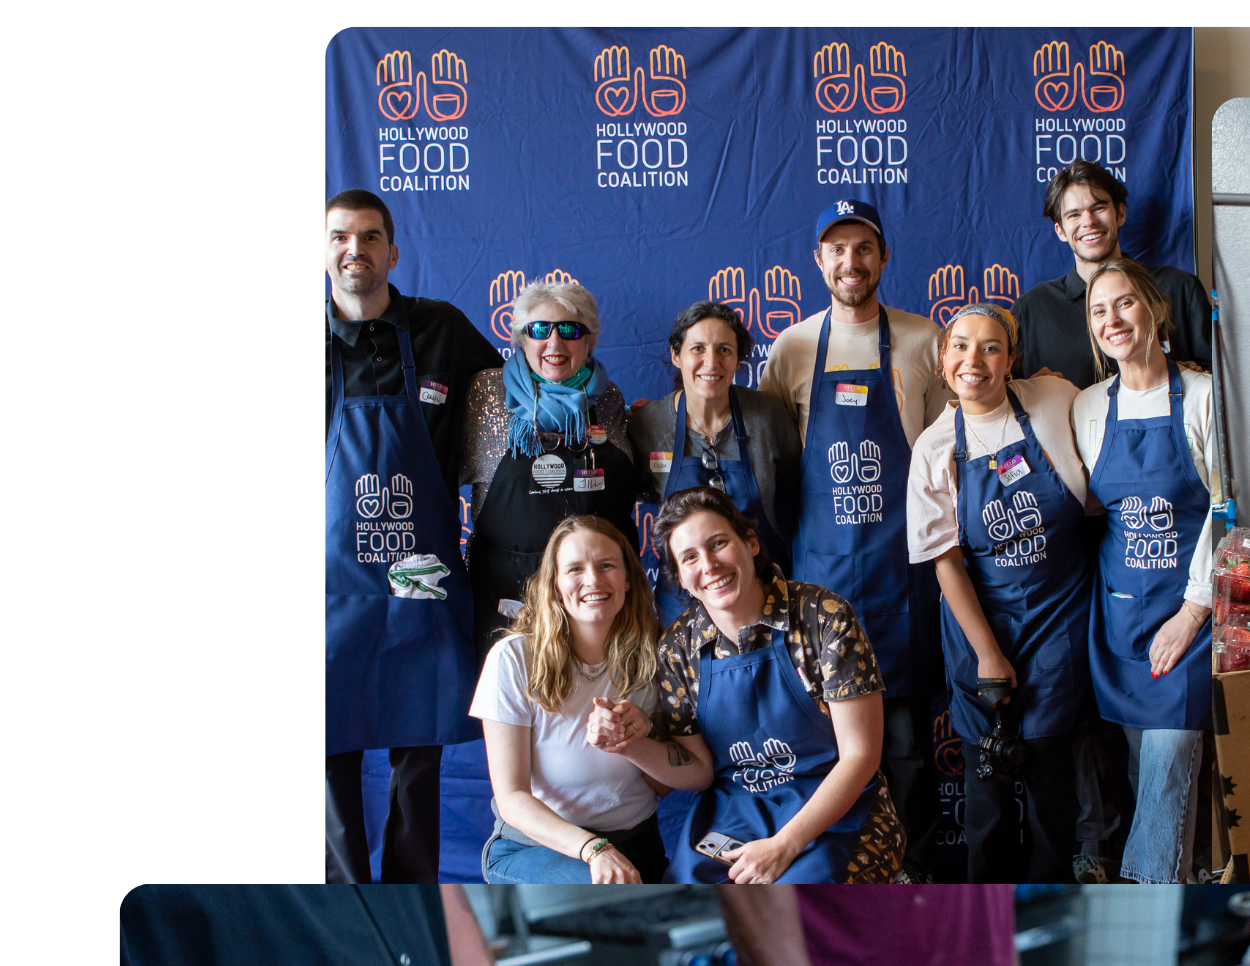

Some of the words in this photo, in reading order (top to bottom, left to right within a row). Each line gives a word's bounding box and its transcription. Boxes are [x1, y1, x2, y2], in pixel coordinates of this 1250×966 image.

[596, 121, 688, 137] HOLLYWOOD
[816, 119, 907, 134] HOLLYWOOD
[1035, 118, 1126, 132] HOLLYWOOD
[378, 126, 469, 142] HOLLYWOOD
[379, 142, 470, 174] FOOD
[597, 138, 688, 170] FOOD
[816, 135, 908, 166] FOOD
[1036, 134, 1126, 165] FOOD
[380, 174, 470, 192] COALITION
[597, 170, 688, 188] COALITION
[817, 167, 908, 184] COALITION
[836, 200, 854, 215] LA
[841, 394, 858, 405] Joey
[832, 484, 882, 495] HOLLYWOOD
[834, 494, 883, 514] FOOD
[356, 521, 414, 531] HOLLYWOOD
[836, 513, 882, 525] COALITION
[356, 532, 416, 552] FOOD
[1126, 538, 1178, 558] FOOD
[995, 550, 1047, 567] COALITION
[1126, 557, 1177, 569] COALITION
[742, 776, 794, 793] ALITION
